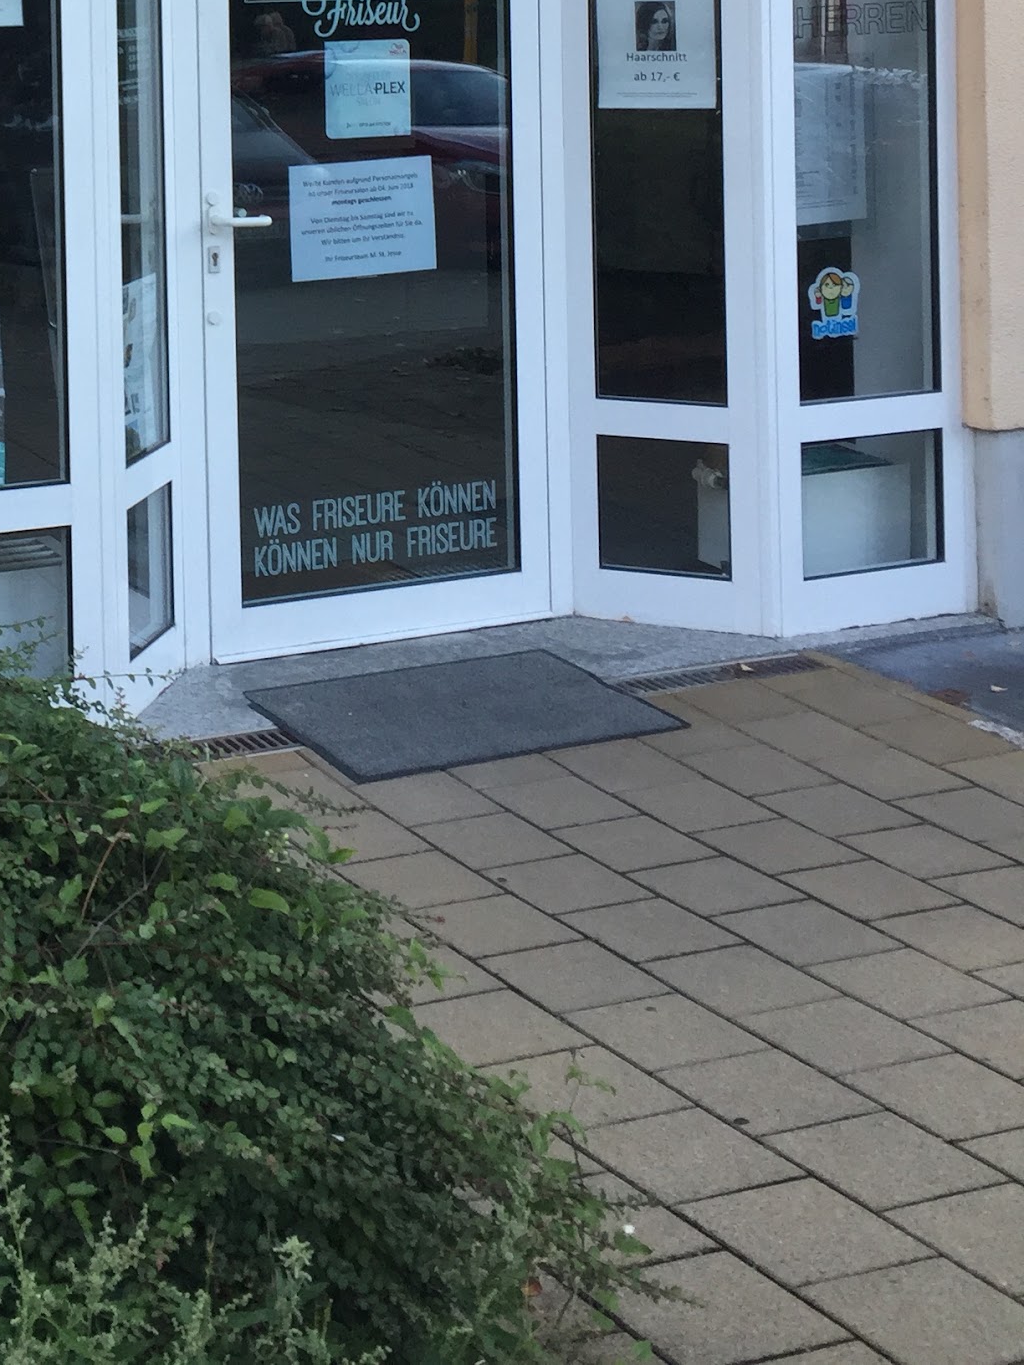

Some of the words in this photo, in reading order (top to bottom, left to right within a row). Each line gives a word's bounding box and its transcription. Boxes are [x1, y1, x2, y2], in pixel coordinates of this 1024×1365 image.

[626, 52, 687, 64] Haarschnitt
[634, 71, 648, 83] ab
[673, 71, 681, 82] €
[253, 502, 300, 538] WAS
[312, 490, 406, 532] FRISEURE
[417, 480, 497, 519] KÖNNEN
[253, 536, 338, 579] KÖNNEN
[351, 529, 394, 563] NUR
[406, 517, 498, 559] FRISEURE
